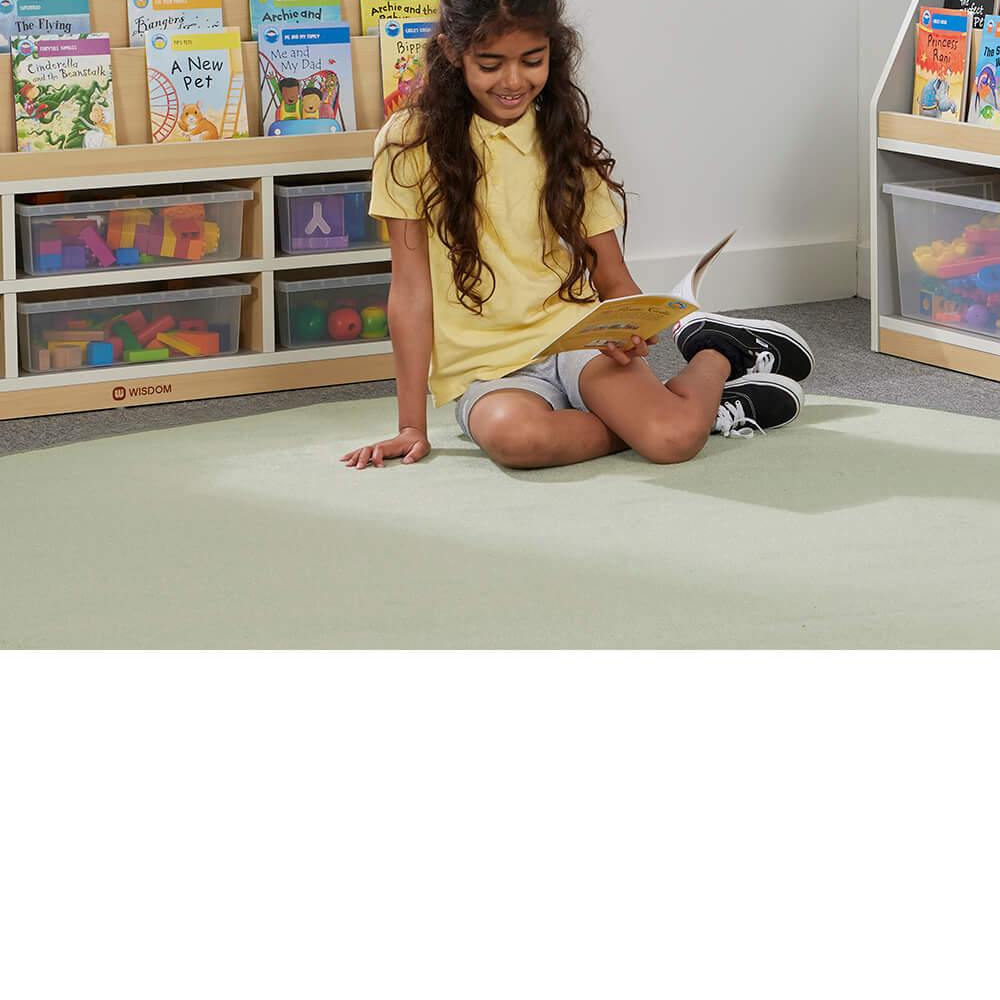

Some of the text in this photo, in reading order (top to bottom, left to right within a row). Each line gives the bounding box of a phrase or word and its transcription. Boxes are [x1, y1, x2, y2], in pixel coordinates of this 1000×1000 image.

[262, 8, 322, 22] Archie and
[371, 1, 438, 16] Archie and the
[14, 18, 72, 33] The Flying
[134, 16, 185, 34] Bangers
[927, 34, 959, 50] Princess
[271, 46, 310, 60] Me and
[932, 48, 951, 63] Rani
[984, 46, 995, 57] The
[27, 58, 79, 74] Cinderella
[171, 55, 224, 75] A New
[281, 58, 322, 73] My Dad
[33, 65, 107, 83] and the Beanstalk
[183, 75, 213, 91] Pet
[128, 383, 173, 398] WISDOM
